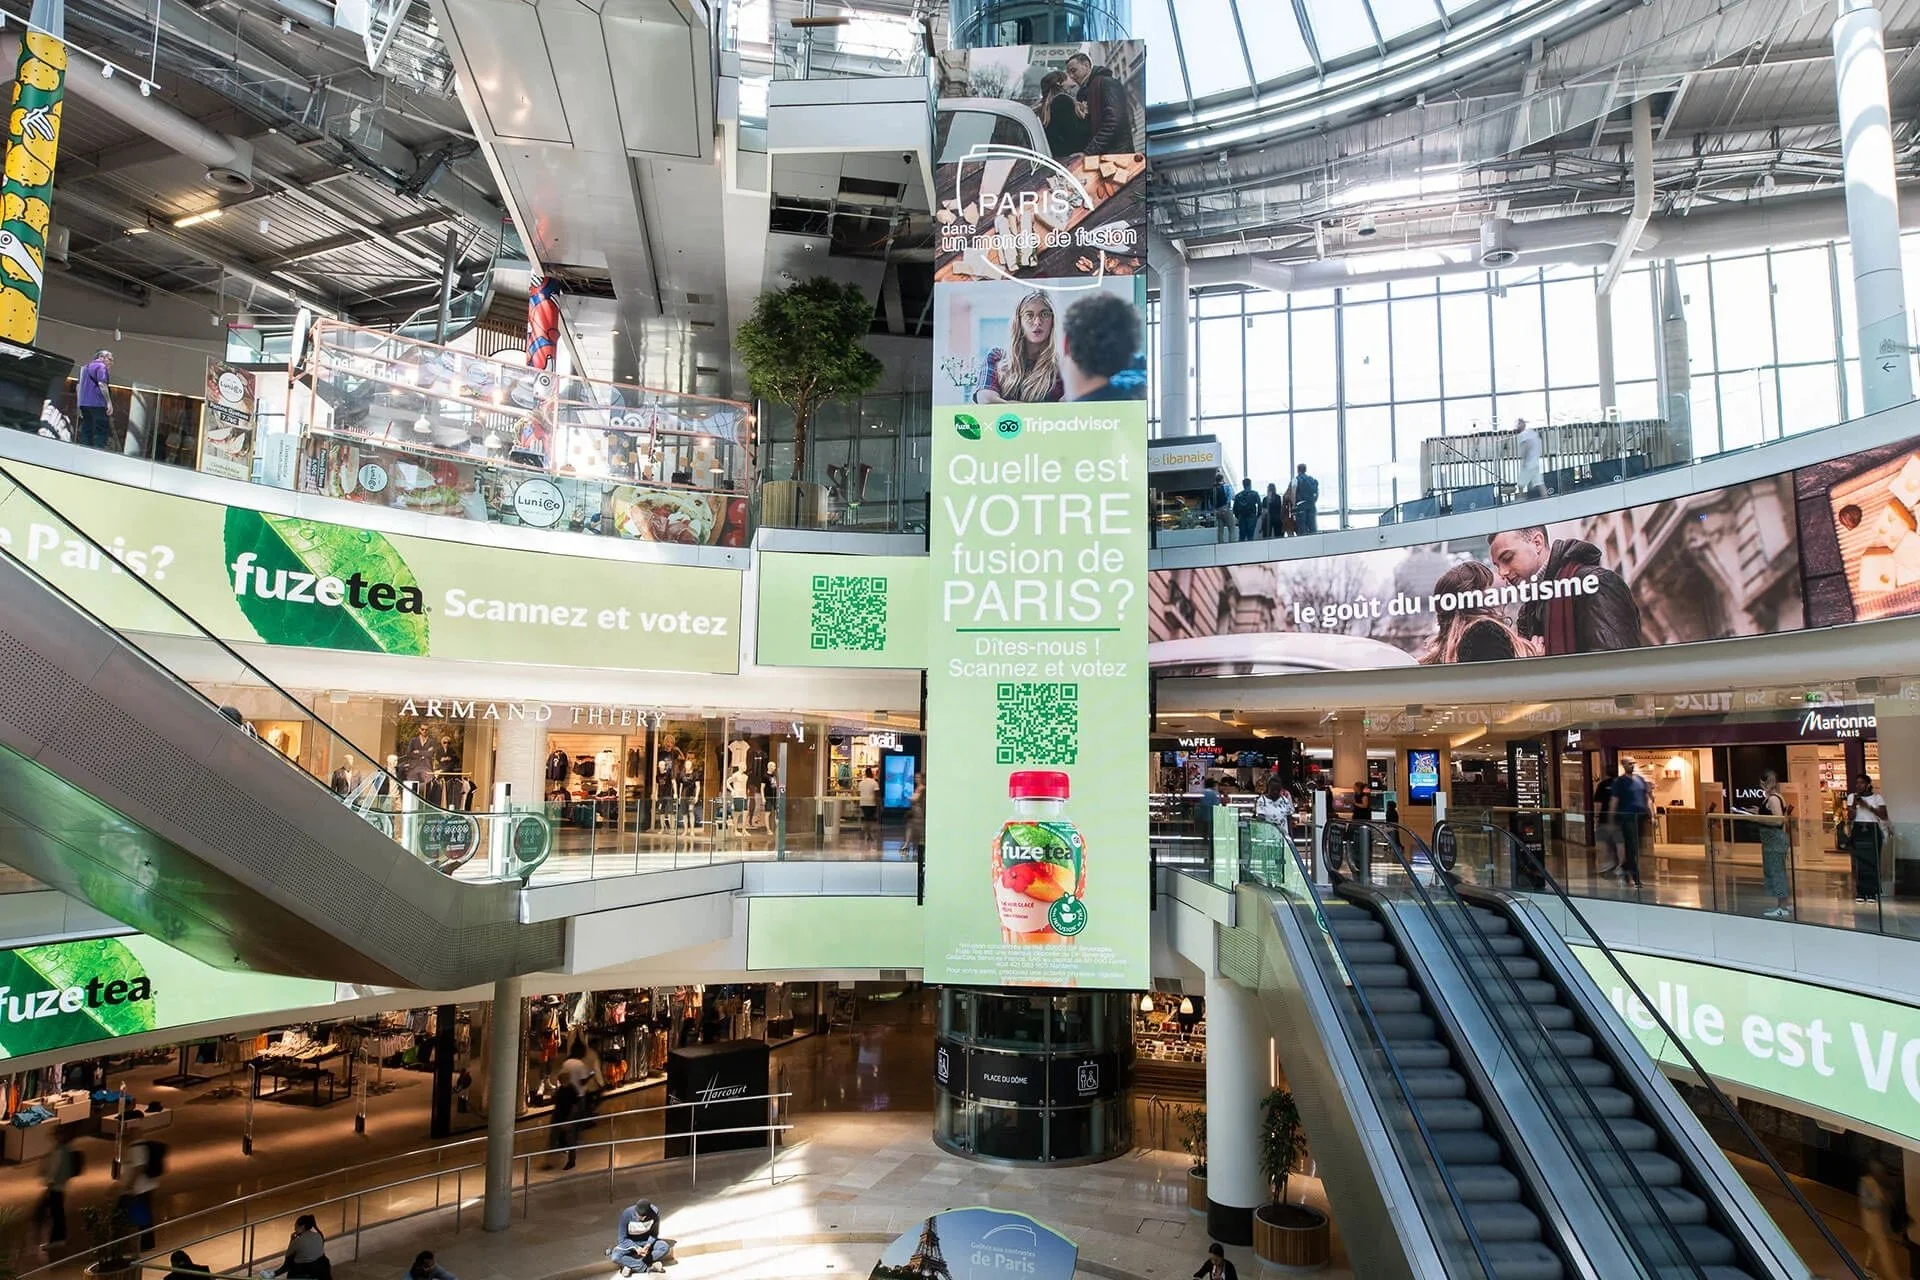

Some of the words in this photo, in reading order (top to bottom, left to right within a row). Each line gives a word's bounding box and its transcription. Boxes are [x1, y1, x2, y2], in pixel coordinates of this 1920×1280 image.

[979, 189, 1070, 217] PARIS
[941, 223, 977, 235] dans
[942, 235, 968, 251] un
[971, 231, 1041, 250] monde
[1044, 229, 1071, 248] de
[1075, 226, 1137, 247] fusion
[1023, 416, 1120, 434] Tripadvisor
[949, 453, 1061, 485] Quelle
[1075, 454, 1129, 482] est
[1162, 453, 1213, 465] libanaise
[944, 493, 1132, 537] VOTRE
[26, 523, 175, 581] Paris?
[951, 542, 1063, 574] fusion
[1078, 541, 1124, 573] de
[231, 552, 423, 615] fuzetea
[444, 588, 588, 628] Scannez
[597, 607, 631, 630] et
[640, 611, 728, 636] votez
[943, 578, 1135, 622] PARIS?
[1293, 602, 1316, 624] le
[1322, 594, 1381, 627] goût
[1388, 592, 1422, 617] du
[1428, 573, 1600, 613] romantisme
[1094, 637, 1100, 656] !
[949, 658, 1038, 677] Scannez
[1045, 659, 1064, 677] et
[1072, 659, 1127, 677] votez
[398, 698, 552, 722] ARMAND
[569, 707, 667, 729] THIERY
[1178, 737, 1216, 747] WAFFLE
[1836, 730, 1860, 738] PARIS
[1741, 1013, 1835, 1077] est
[695, 1072, 748, 1109] Harcourt
[983, 1073, 1001, 1083] PLACE
[1001, 1075, 1011, 1084] DU
[1010, 1074, 1028, 1085] DÔME
[971, 1251, 992, 1267] de
[995, 1253, 1036, 1274] Paris
